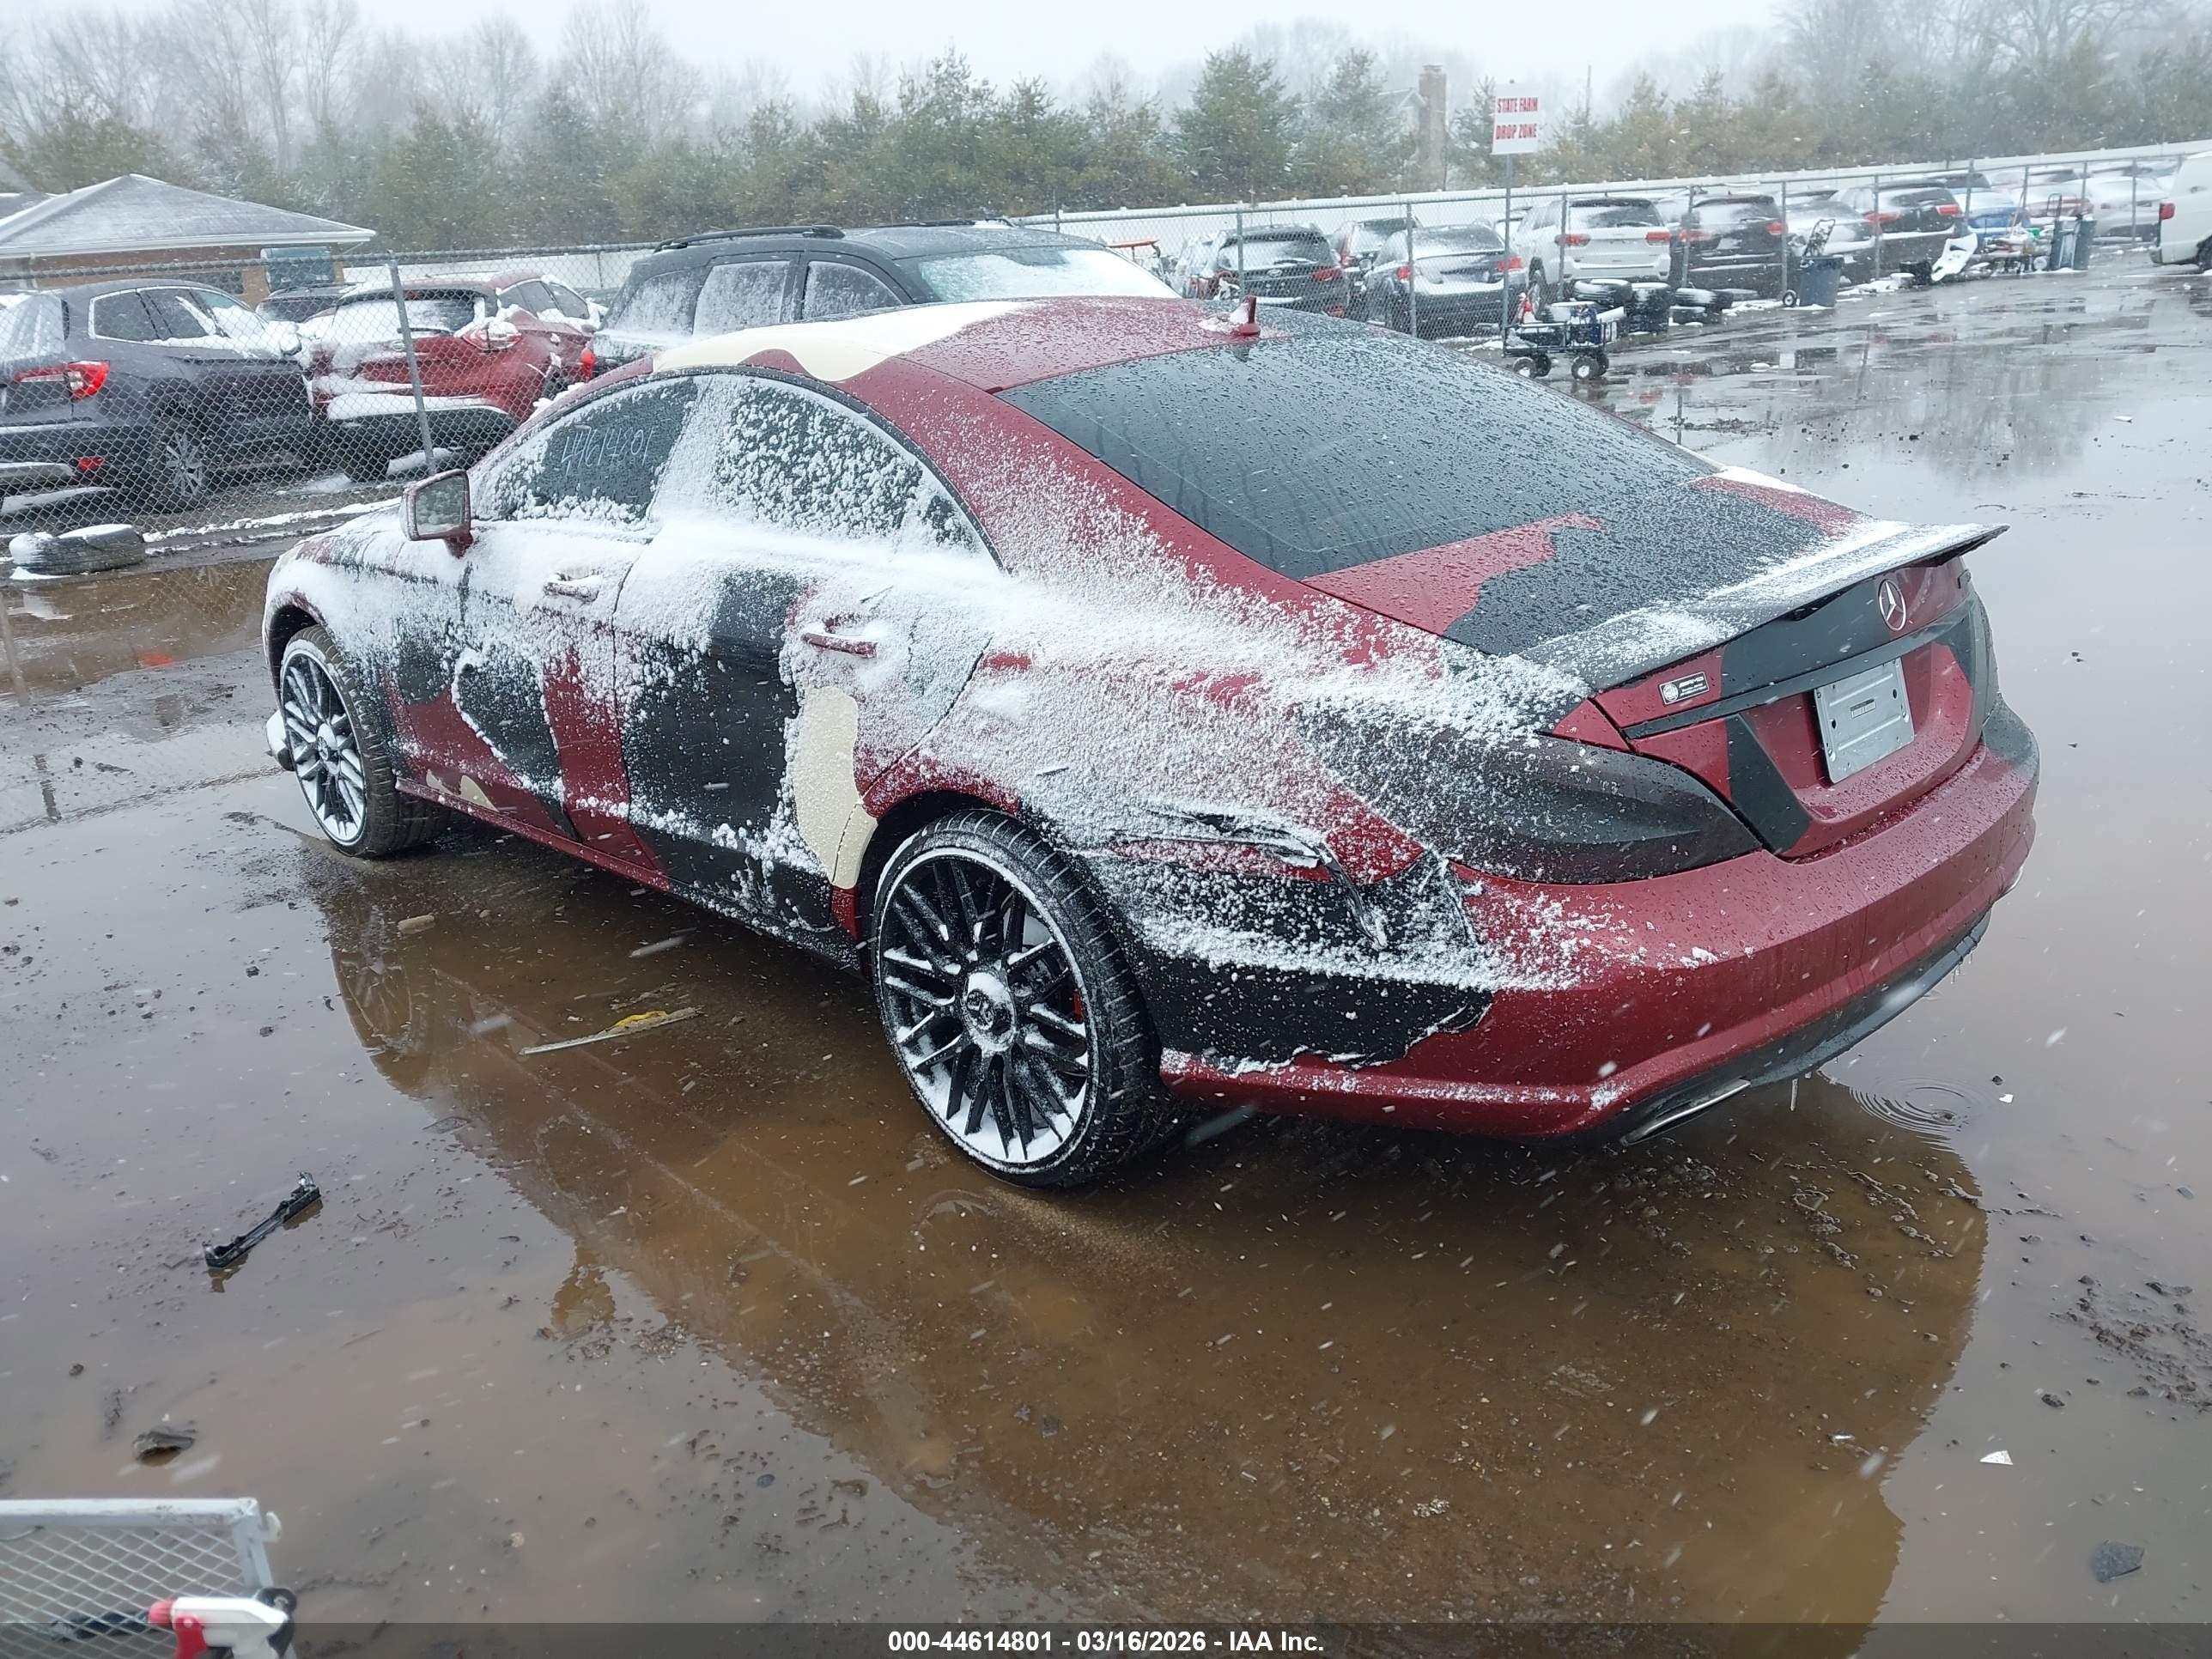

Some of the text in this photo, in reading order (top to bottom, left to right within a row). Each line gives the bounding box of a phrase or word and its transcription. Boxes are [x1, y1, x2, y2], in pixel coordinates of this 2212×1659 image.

[1497, 96, 1538, 112] STATE FARM
[1496, 123, 1537, 139] DROP ZONE
